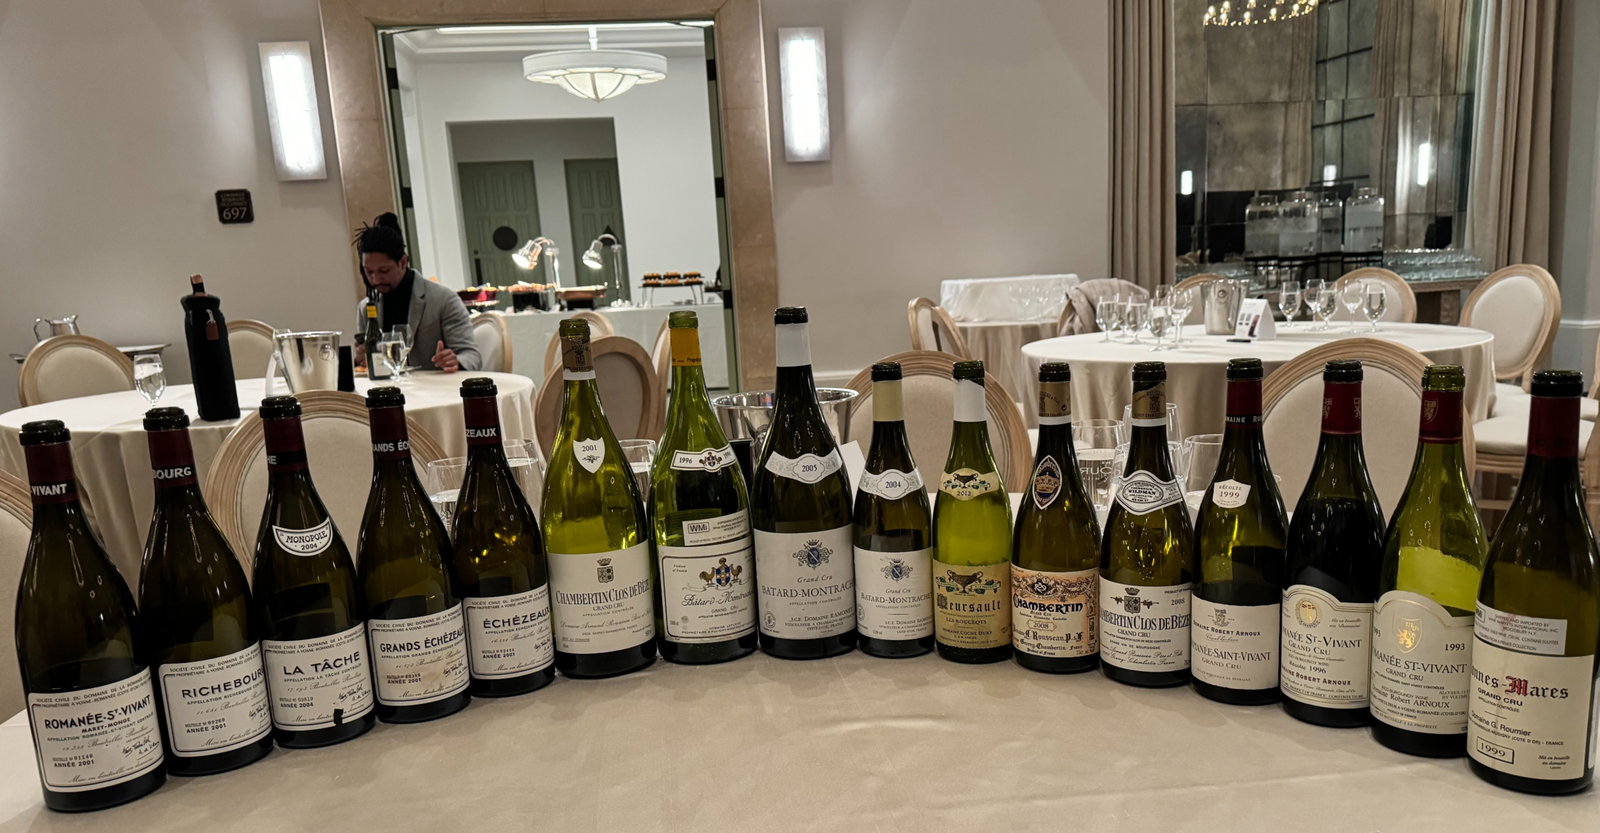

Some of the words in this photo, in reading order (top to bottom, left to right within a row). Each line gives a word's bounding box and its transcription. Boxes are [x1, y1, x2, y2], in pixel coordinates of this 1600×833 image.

[223, 207, 247, 220] 697
[32, 484, 67, 496] VIVANT
[286, 530, 328, 543] MONOPOLE
[797, 575, 818, 583] Grand
[380, 641, 420, 652] GRANDS
[1288, 640, 1311, 652] GRAND
[1313, 647, 1331, 655] CRU
[1444, 643, 1465, 651] 1993
[283, 666, 304, 675] LA
[311, 651, 360, 673] TÂCHE
[1404, 661, 1467, 673] ST-VIVANT
[1296, 672, 1320, 683] ROBERT
[1386, 668, 1406, 678] GRAND
[1390, 694, 1410, 704] Robert
[1414, 700, 1450, 708] ARNOUX
[1477, 687, 1501, 700] GRAND
[1503, 697, 1523, 706] CRU
[186, 725, 209, 734] ANNÉE
[1491, 721, 1499, 730] G.
[1500, 724, 1532, 736] Roumier
[1479, 742, 1506, 757] 1999
